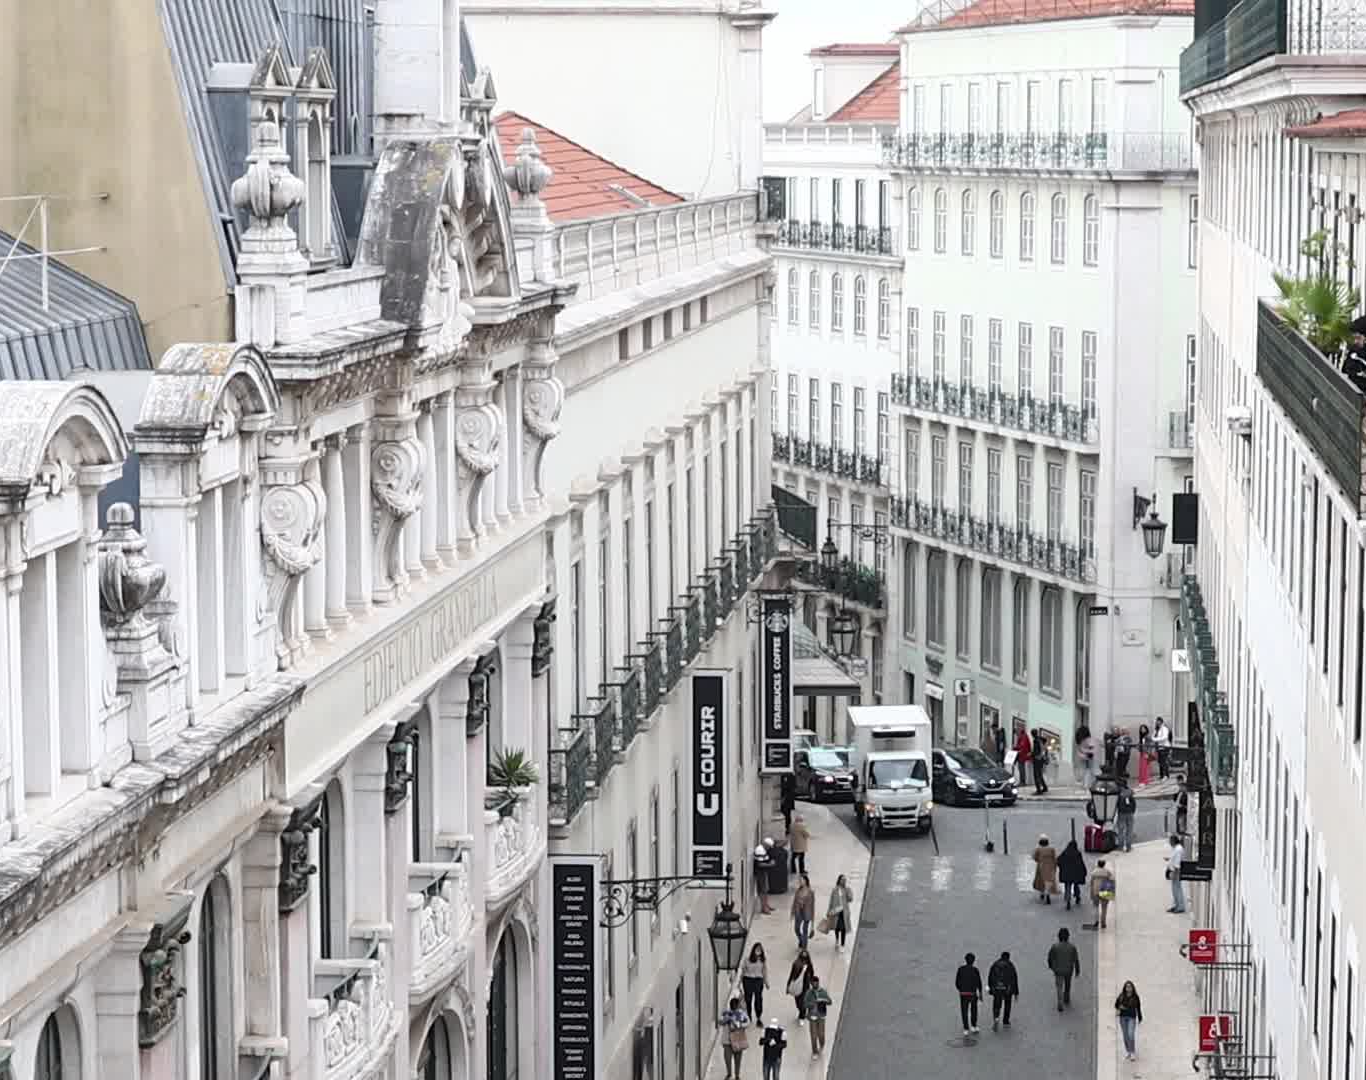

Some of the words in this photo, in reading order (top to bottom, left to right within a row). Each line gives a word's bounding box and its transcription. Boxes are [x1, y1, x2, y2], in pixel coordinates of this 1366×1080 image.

[773, 636, 782, 671] COFFEE
[773, 673, 782, 730] STARBUCKS
[700, 706, 715, 787] COURIR
